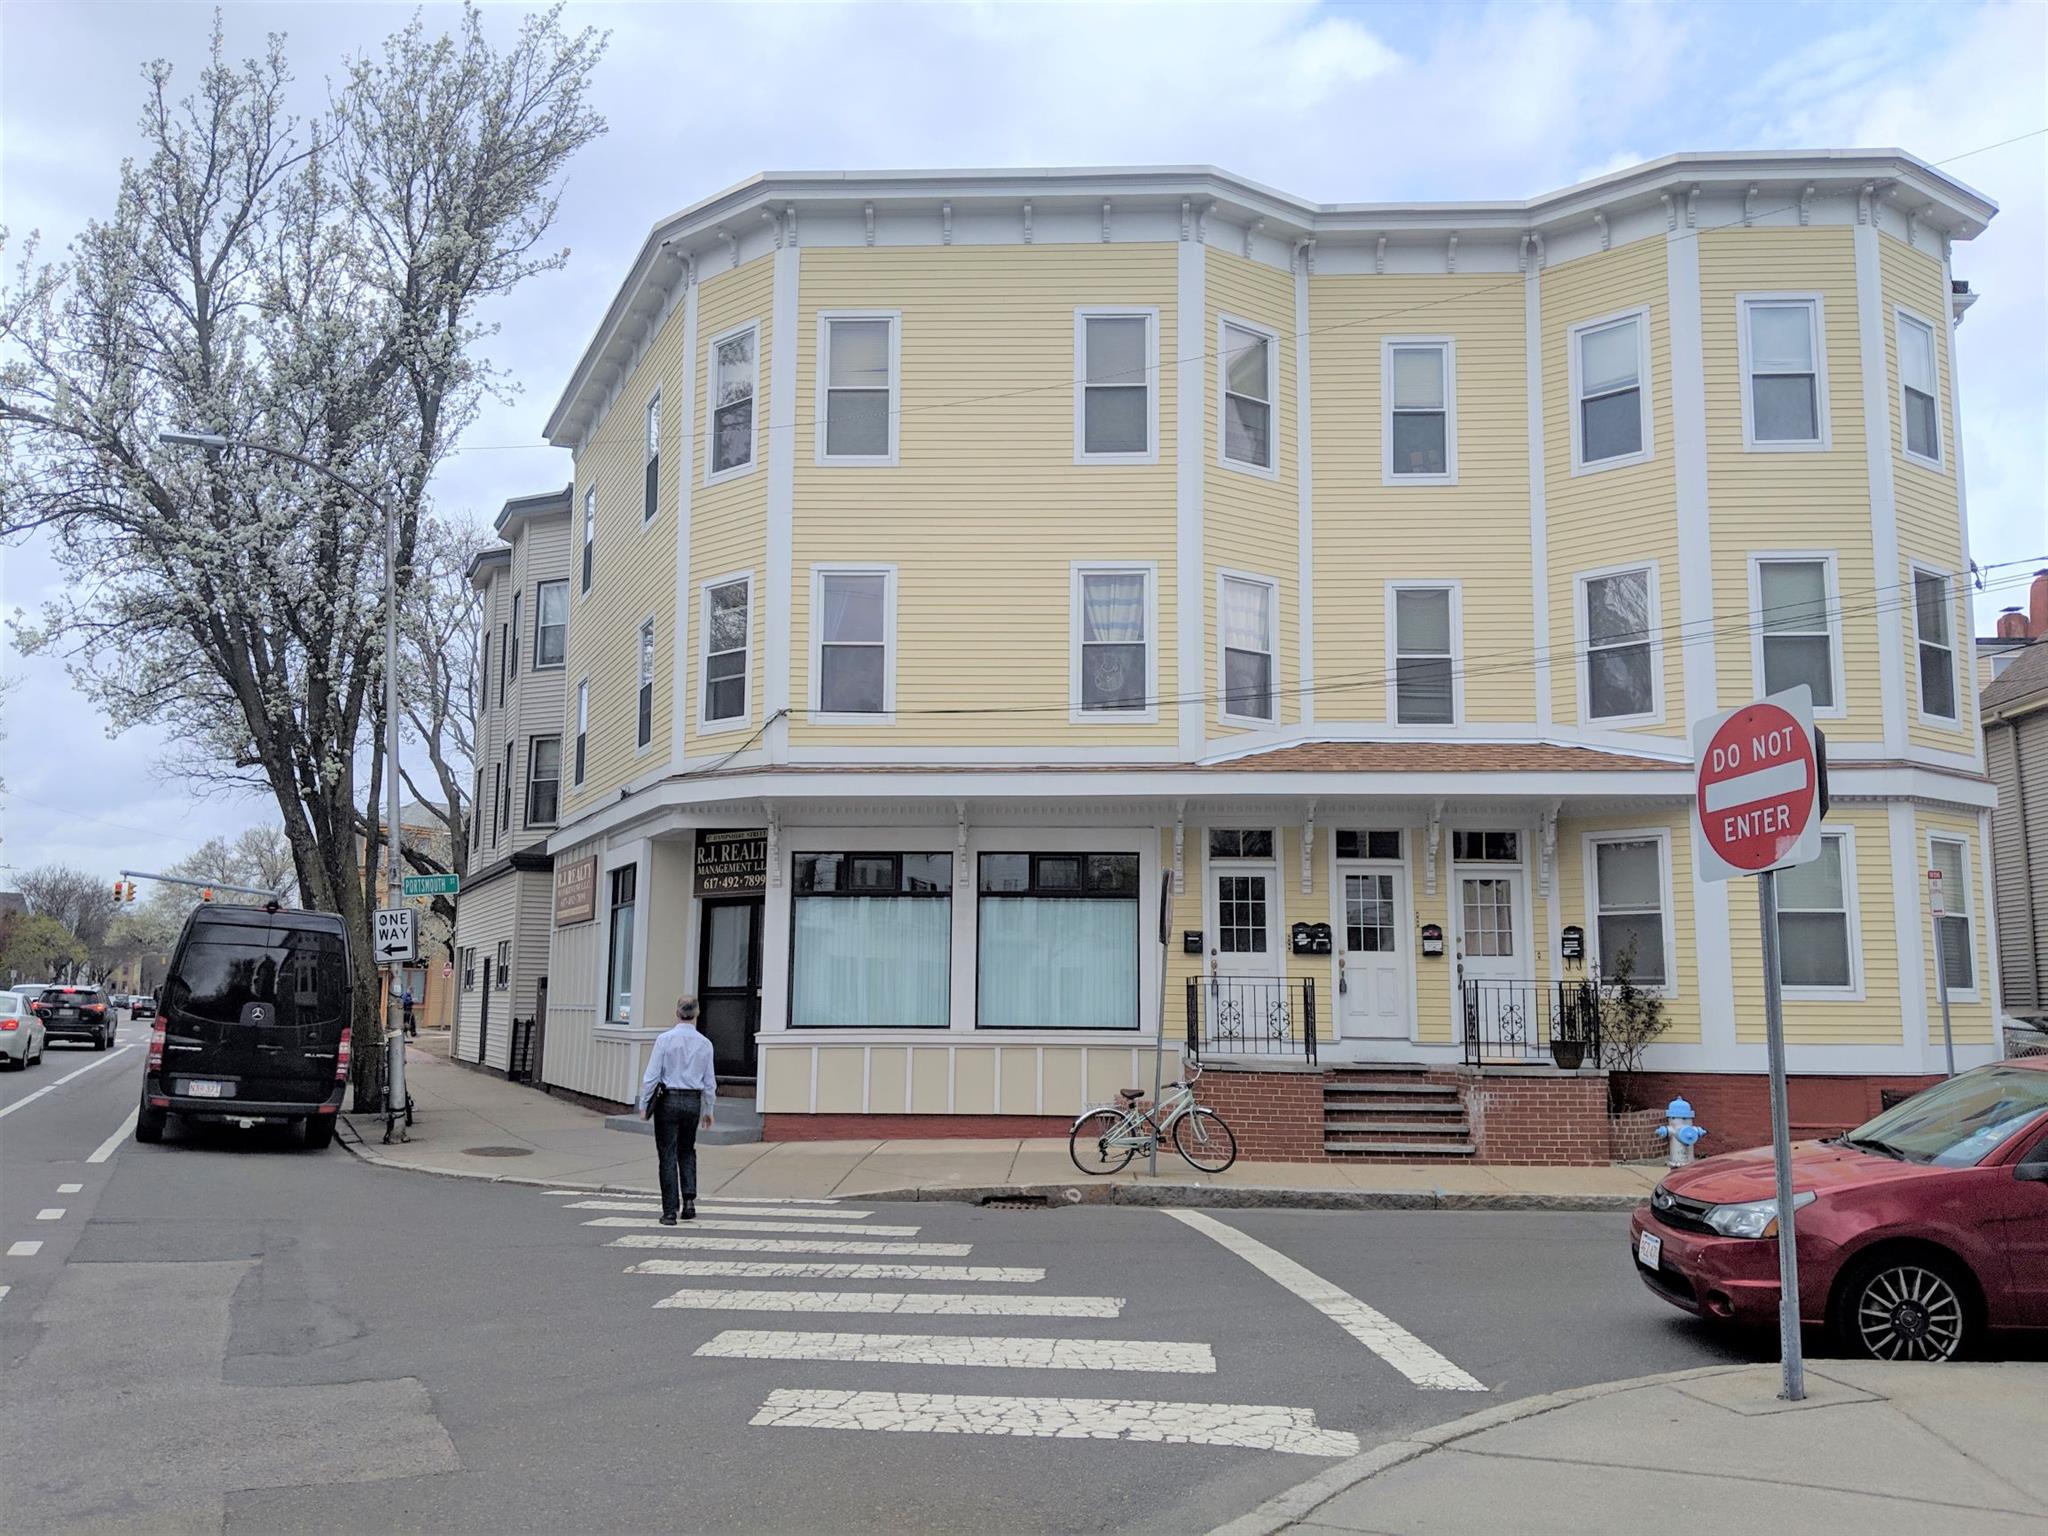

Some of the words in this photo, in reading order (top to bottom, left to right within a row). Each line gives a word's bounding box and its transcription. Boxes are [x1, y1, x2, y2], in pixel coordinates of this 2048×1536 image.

[1713, 744, 1740, 773] DO
[1752, 726, 1793, 761] NOT
[1724, 804, 1791, 842] ENTER
[696, 845, 718, 865] R.J.
[721, 841, 767, 862] REALT
[697, 862, 752, 875] MANAGEMENT
[405, 878, 446, 894] PORTSMOUTH
[379, 912, 408, 926] ONE
[379, 927, 408, 940] WAY
